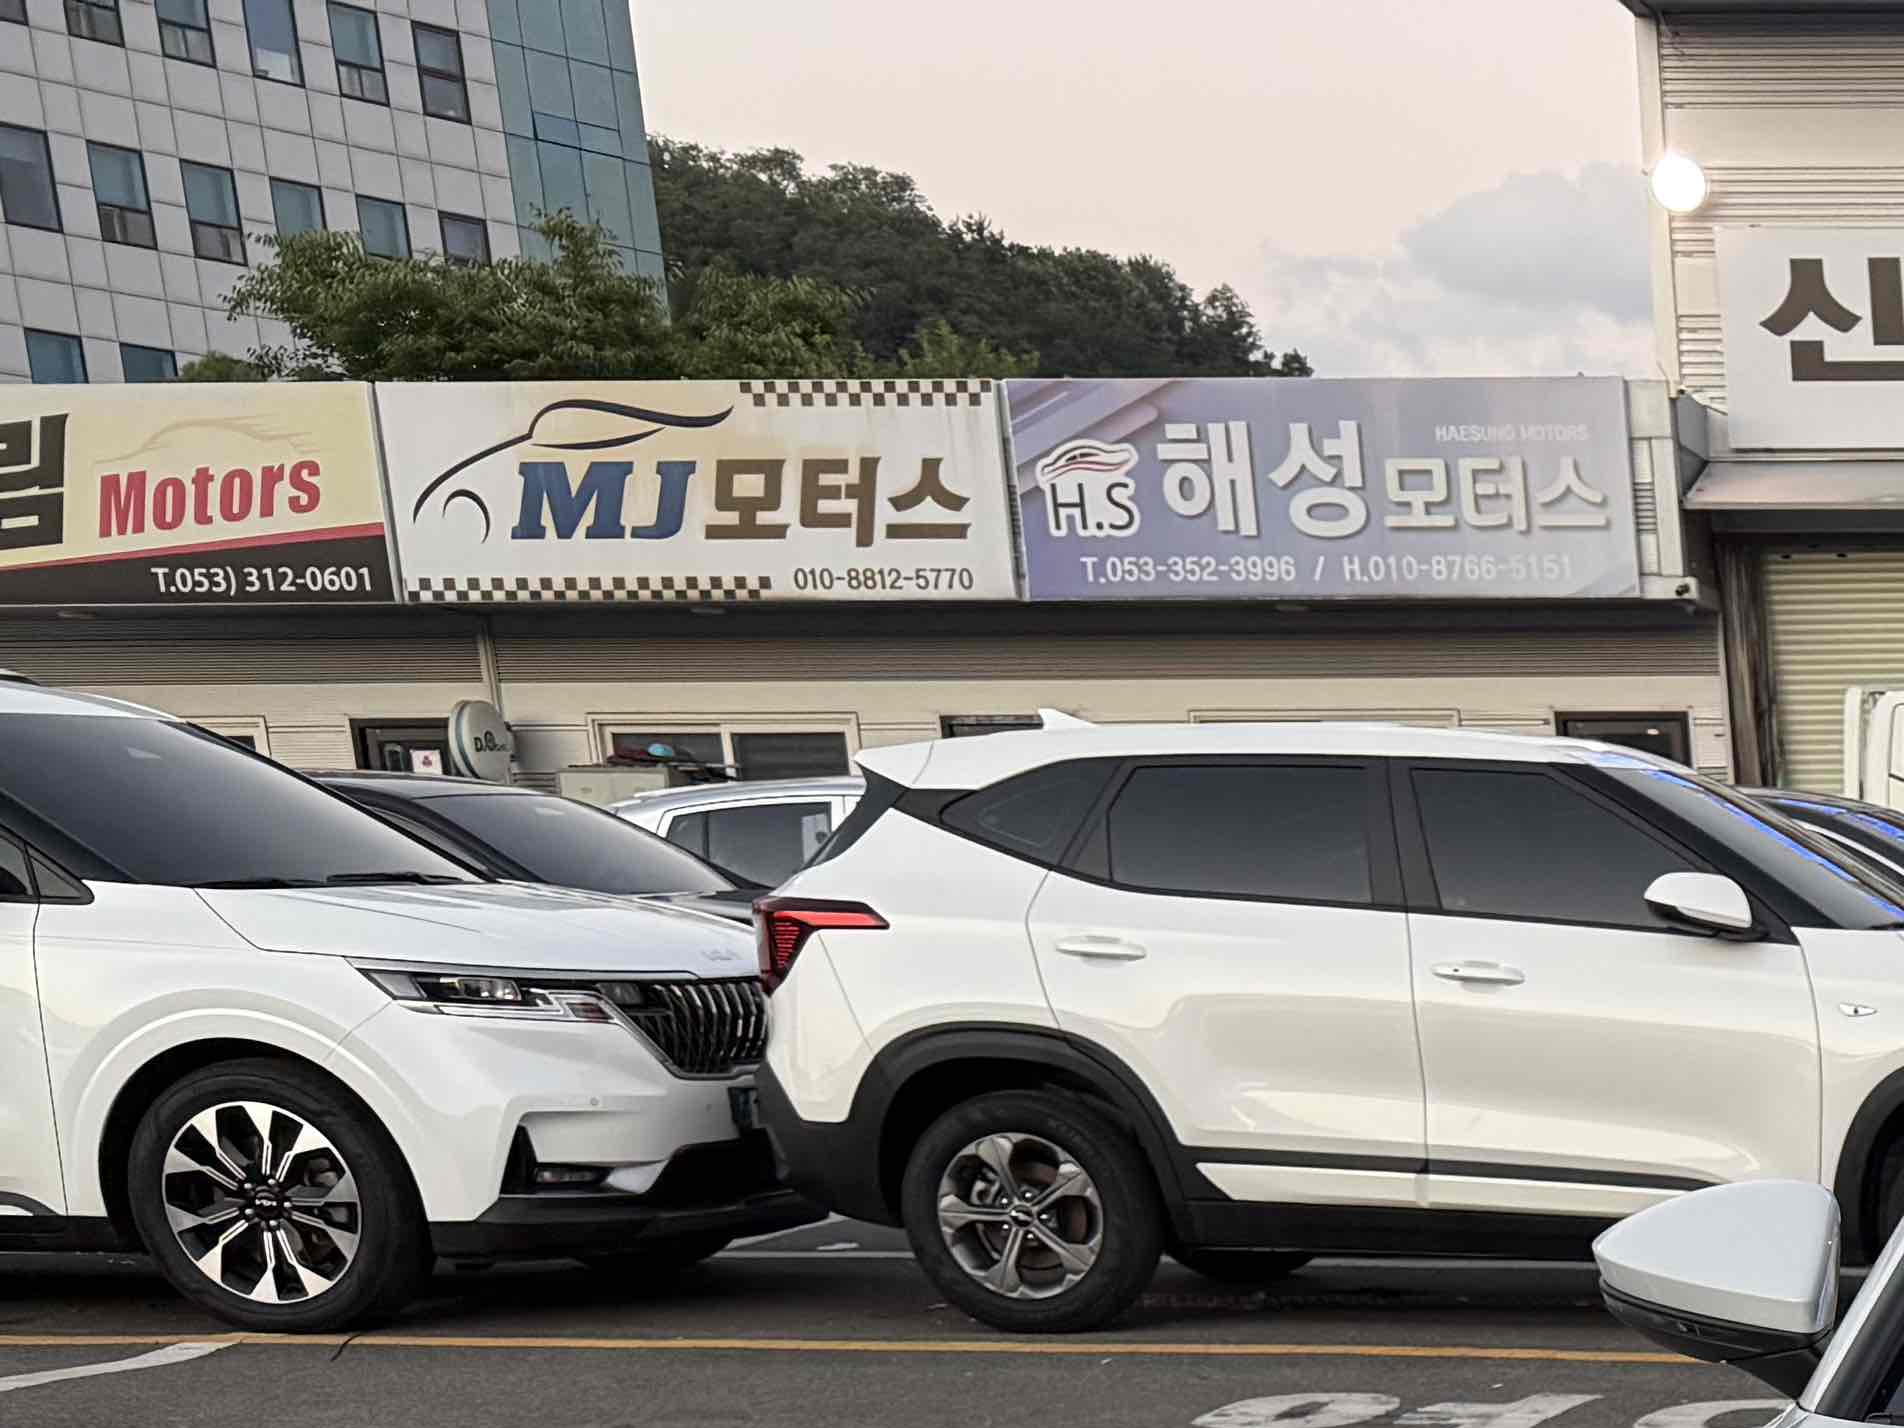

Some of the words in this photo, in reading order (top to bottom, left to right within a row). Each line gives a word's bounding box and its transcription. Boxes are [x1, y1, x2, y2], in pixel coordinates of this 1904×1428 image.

[1434, 425, 1515, 442] HAESUNG
[1519, 424, 1591, 441] MOTORS
[1157, 420, 1370, 539] 해성
[1385, 455, 1610, 534] 모터스
[98, 459, 321, 539] Motors
[1050, 482, 1135, 531] H.S
[151, 567, 238, 596] T.053)
[244, 565, 373, 594] 312-0601
[793, 566, 974, 593] 010-8812-5770
[1080, 554, 1297, 586] T.053-352-3996
[1342, 553, 1575, 584] H.010-8766-5151
